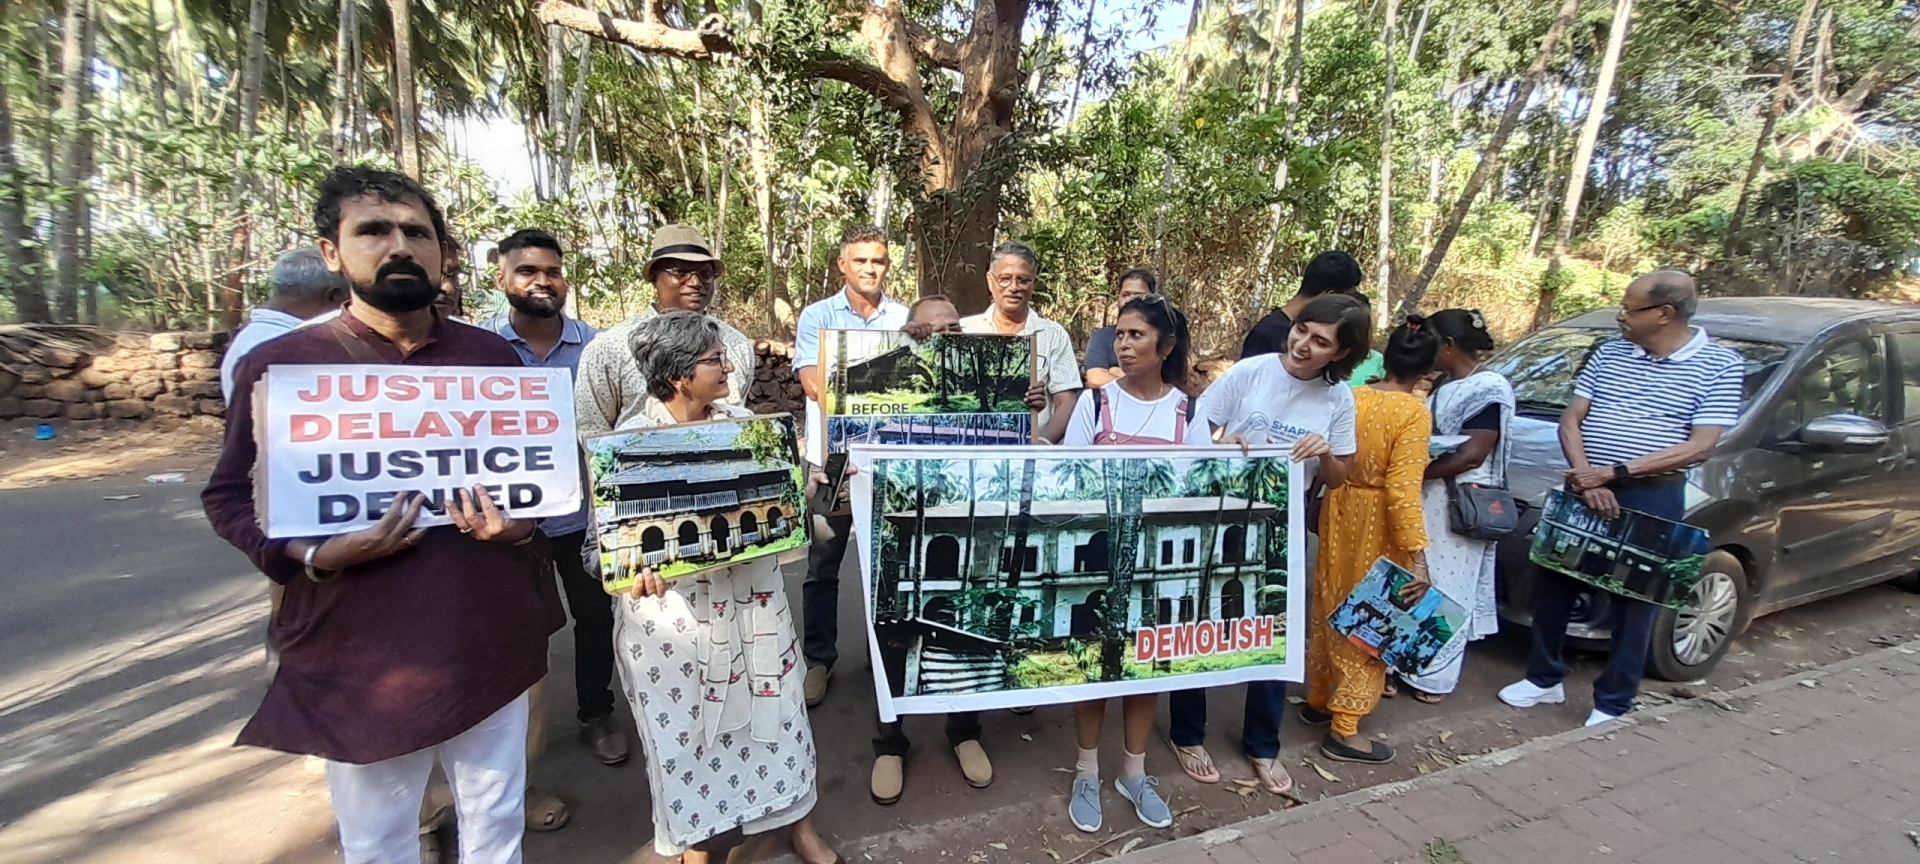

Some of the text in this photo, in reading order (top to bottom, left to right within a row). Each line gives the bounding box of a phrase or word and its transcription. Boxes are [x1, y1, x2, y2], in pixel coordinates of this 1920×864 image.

[297, 374, 550, 402] JUSTICE
[851, 403, 909, 415] BEFORE
[289, 410, 560, 443] DELAYED
[297, 445, 555, 484] JUSTICE
[1136, 616, 1274, 661] DEMOLISH
